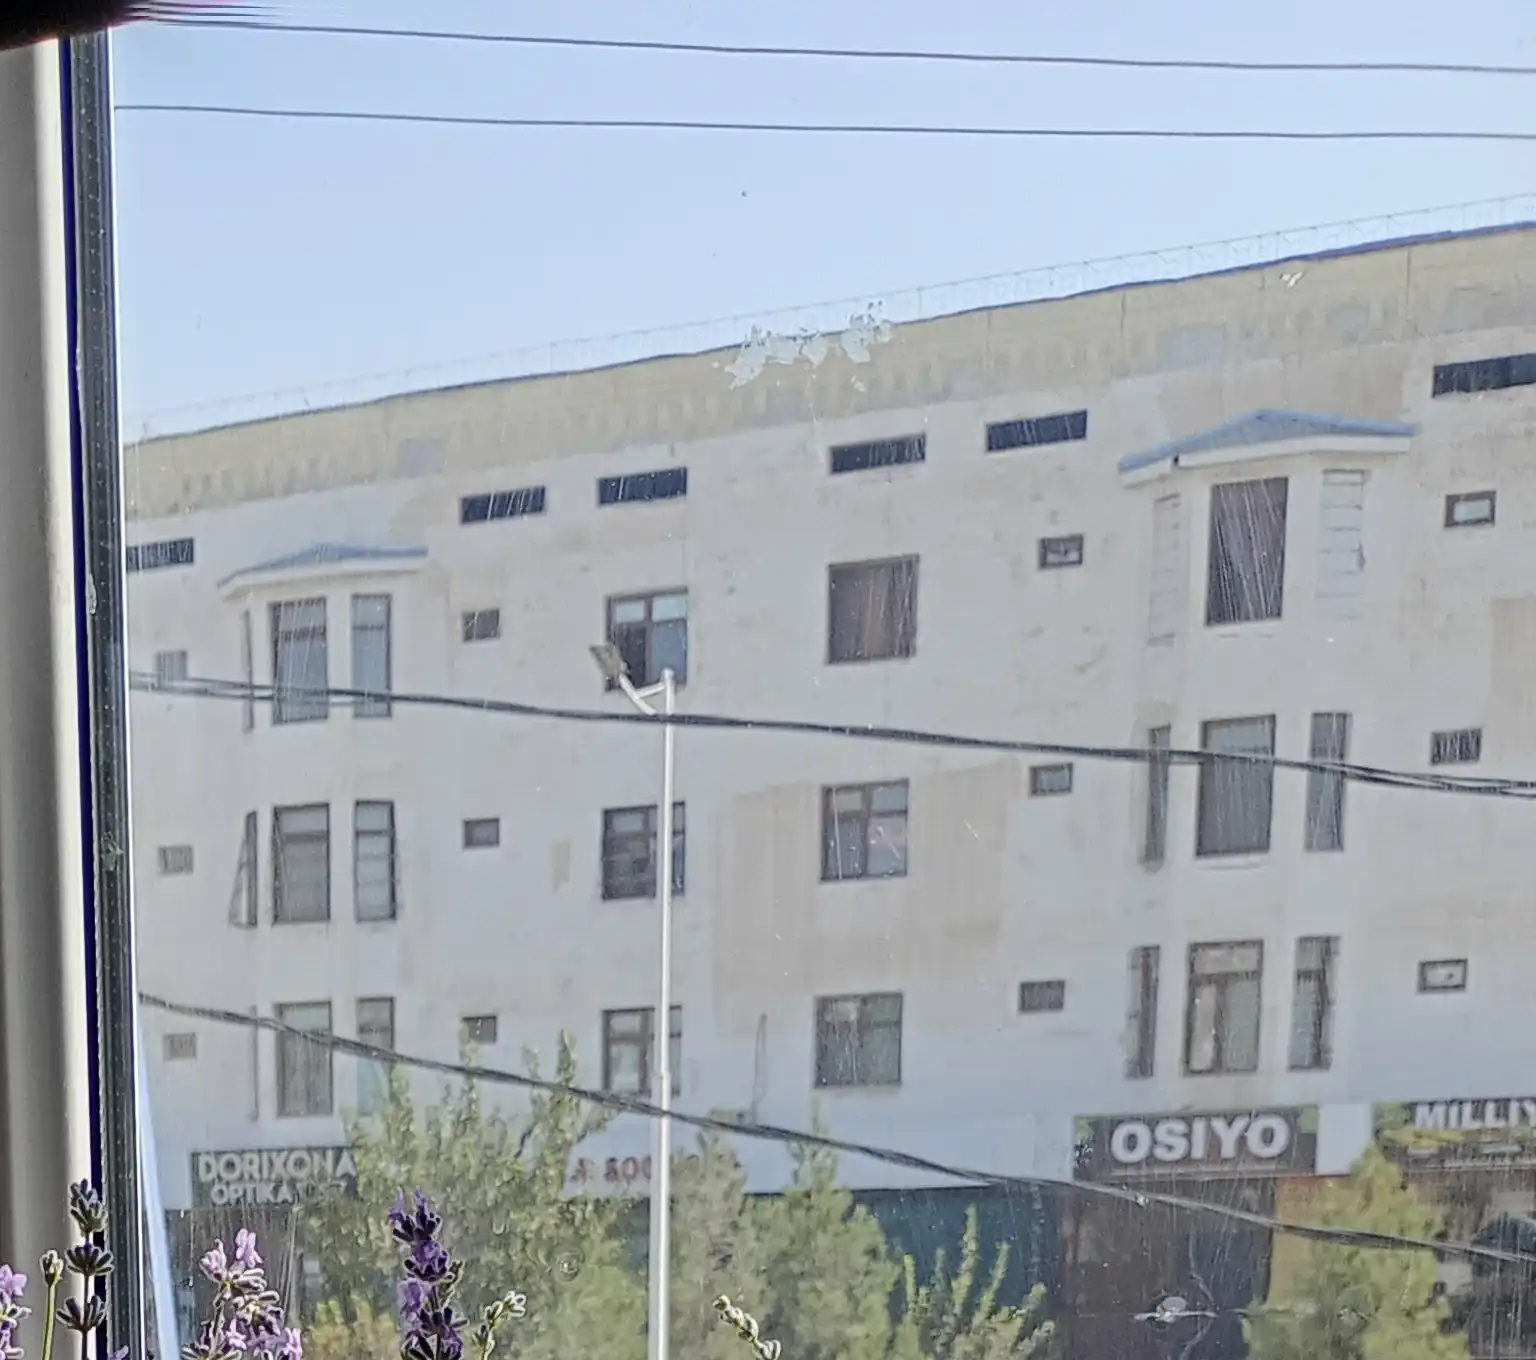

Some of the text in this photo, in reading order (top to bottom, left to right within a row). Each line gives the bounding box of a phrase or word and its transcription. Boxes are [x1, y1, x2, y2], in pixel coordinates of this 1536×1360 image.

[1111, 1113, 1291, 1165] OSIYO
[198, 1148, 358, 1184] DORIXONA
[210, 1181, 295, 1205] OPTIKA
